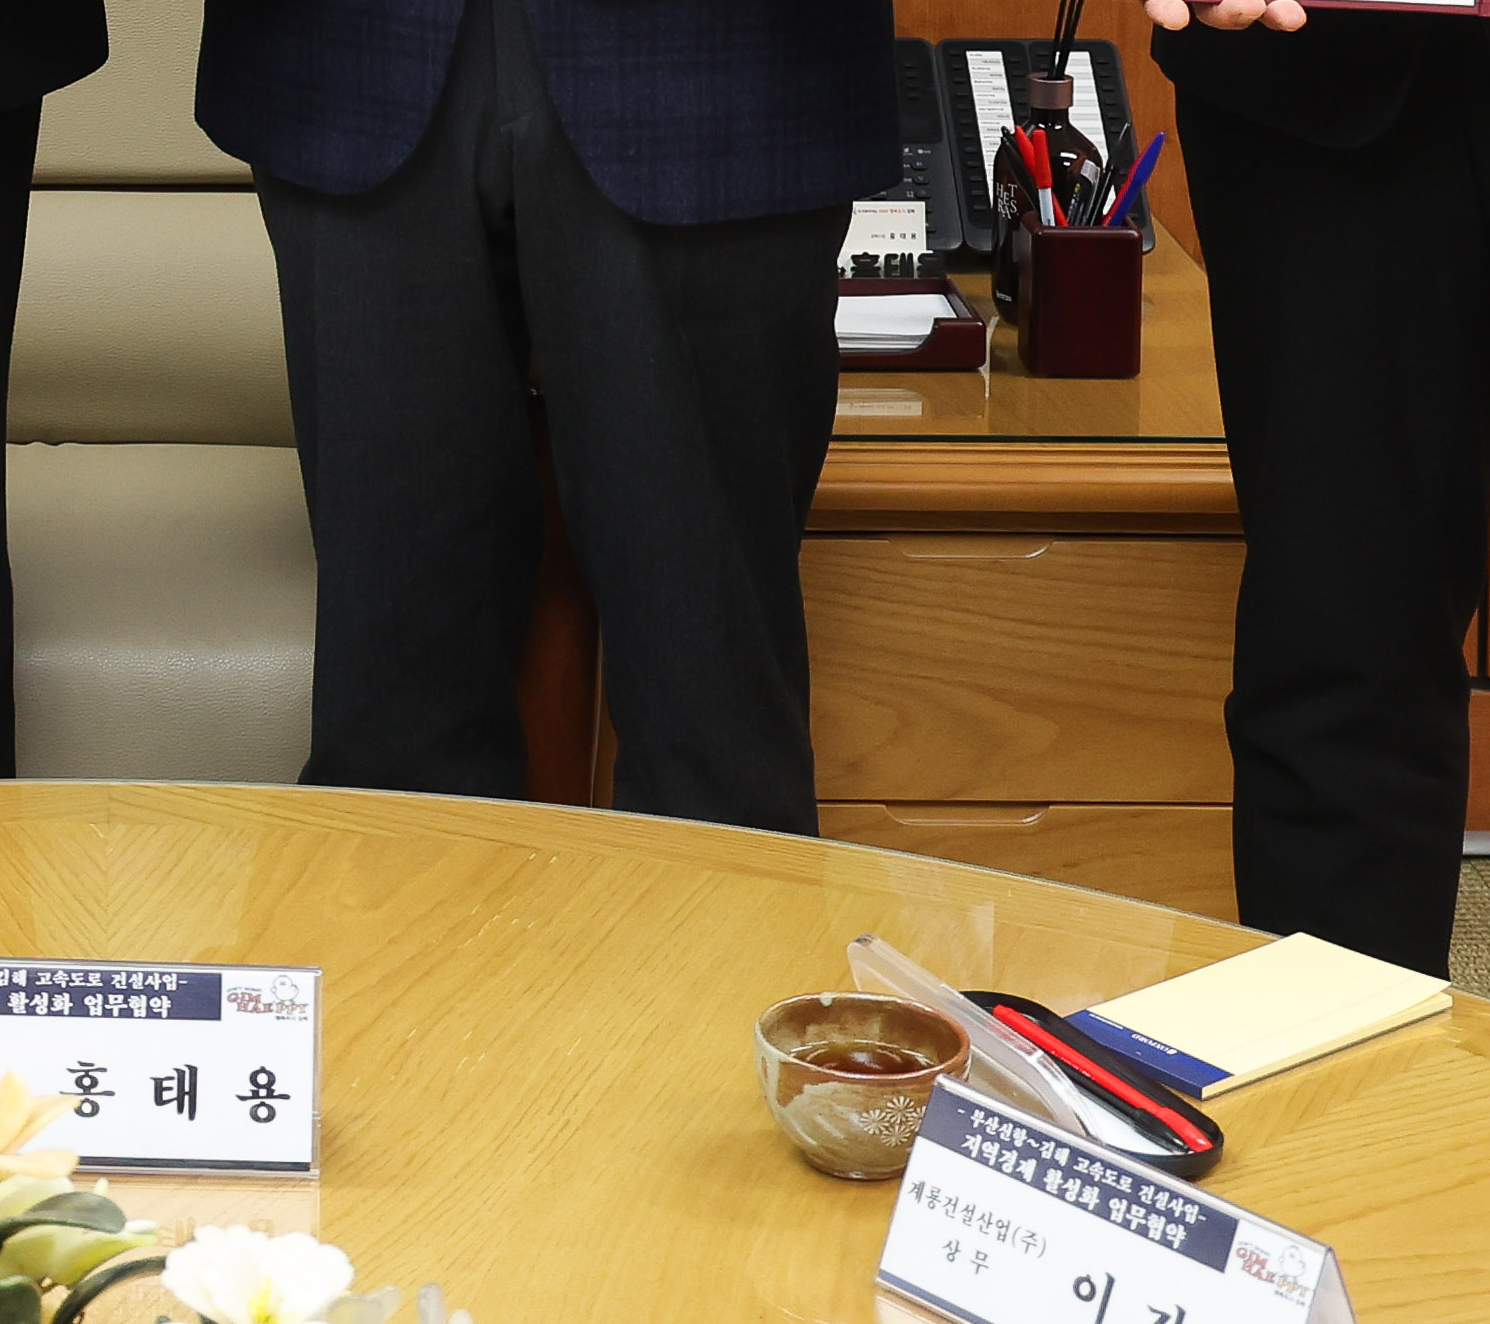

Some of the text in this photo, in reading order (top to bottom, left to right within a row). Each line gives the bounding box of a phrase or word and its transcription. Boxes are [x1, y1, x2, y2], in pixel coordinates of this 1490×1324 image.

[36, 969, 103, 990] 고속도로
[6, 991, 73, 1016] 활성화
[82, 993, 172, 1019] 업무협약
[960, 1132, 1189, 1250] 지역경제 활성화 업무협약
[1071, 1154, 1134, 1195] 고속도로
[906, 1178, 1048, 1259] 계룡건설산업(주)
